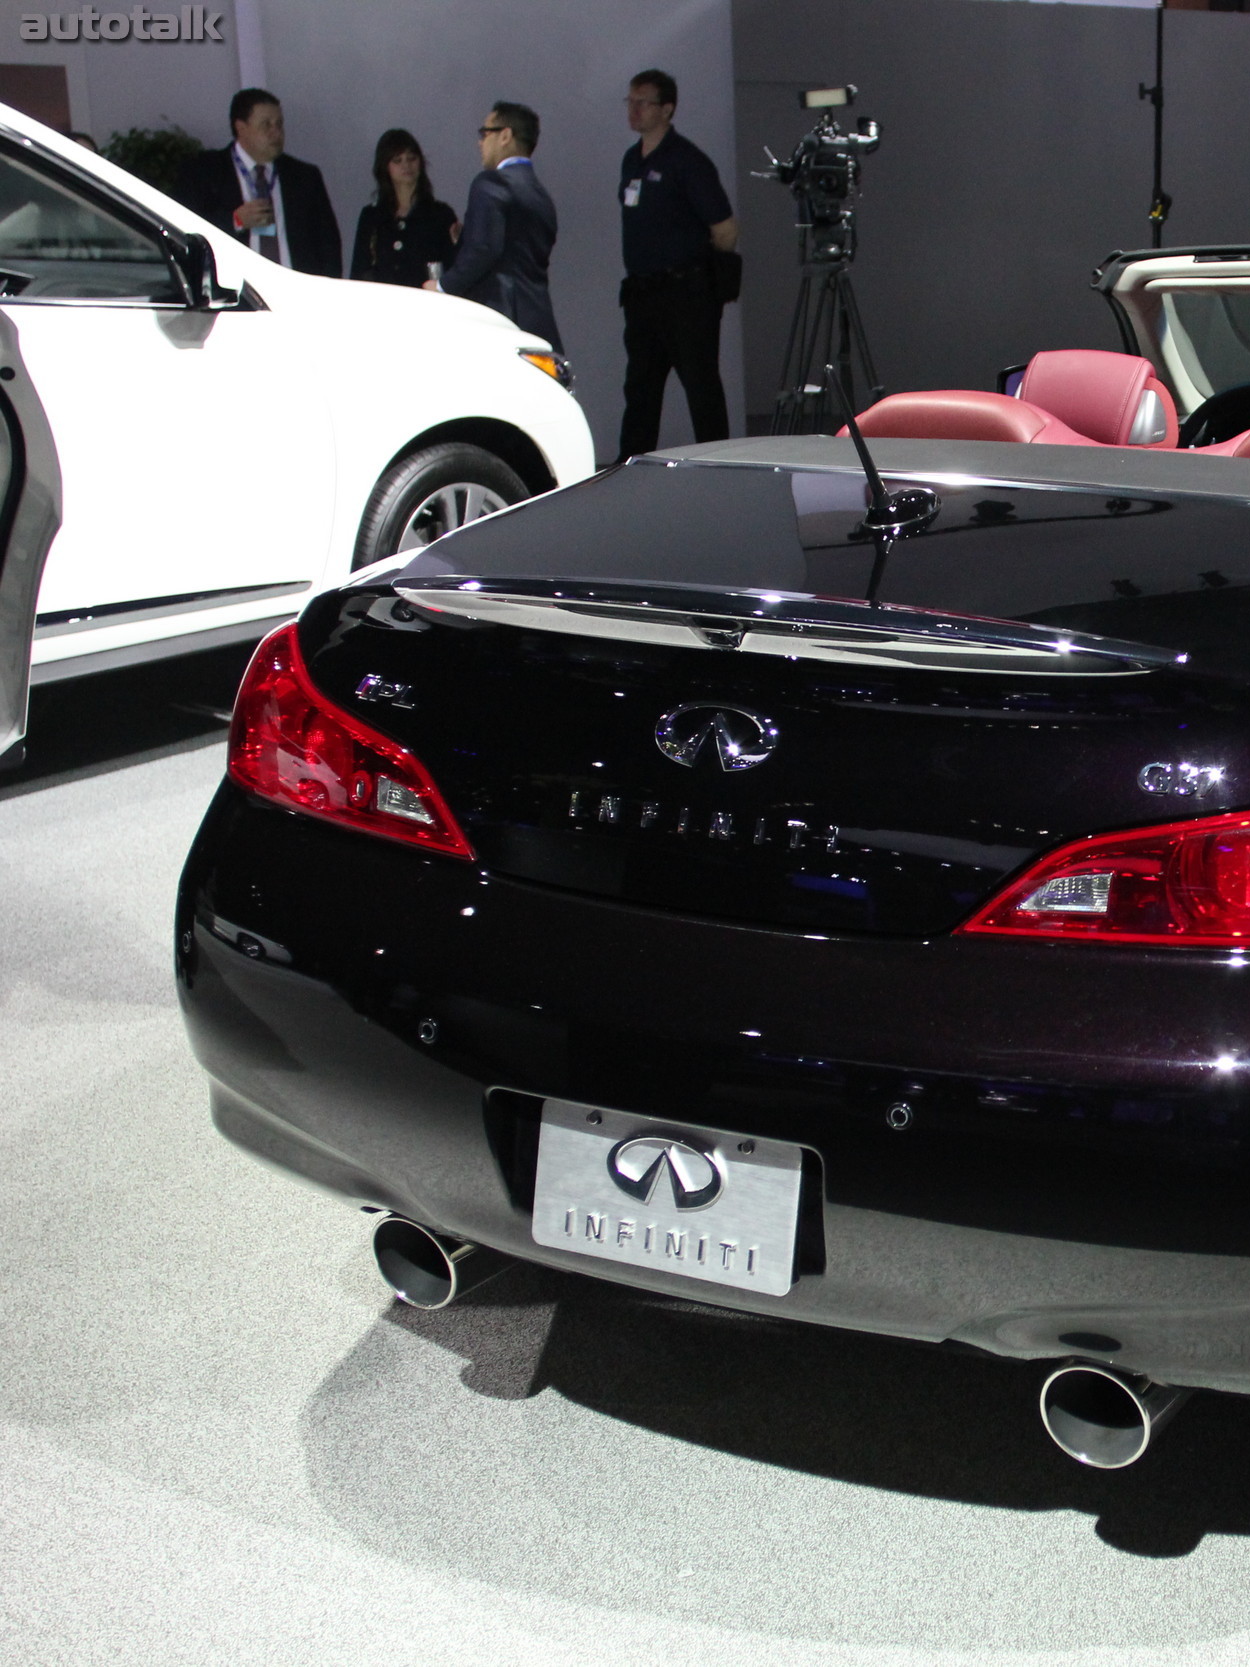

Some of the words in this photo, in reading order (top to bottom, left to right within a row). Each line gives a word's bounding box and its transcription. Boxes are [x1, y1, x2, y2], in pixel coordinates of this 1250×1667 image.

[1138, 762, 1226, 799] G37
[568, 791, 840, 853] INFINITI
[564, 1207, 759, 1275] INFINITI
